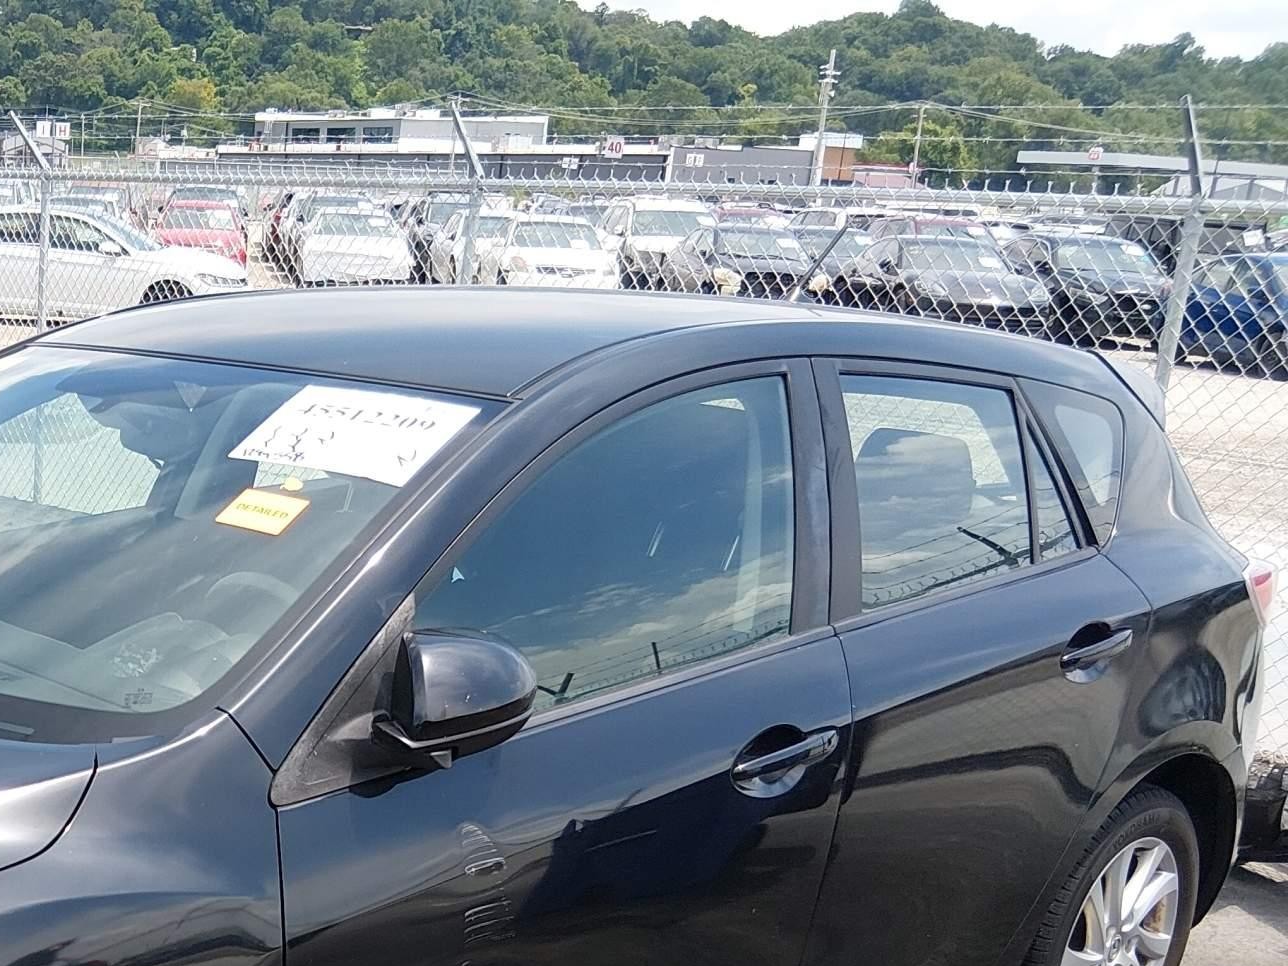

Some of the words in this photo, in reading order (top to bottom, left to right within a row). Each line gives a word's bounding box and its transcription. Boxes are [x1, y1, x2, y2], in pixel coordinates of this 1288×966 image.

[58, 126, 67, 136] H
[607, 141, 622, 153] 40
[298, 403, 436, 431] 45512209
[235, 503, 289, 518] DETAILED
